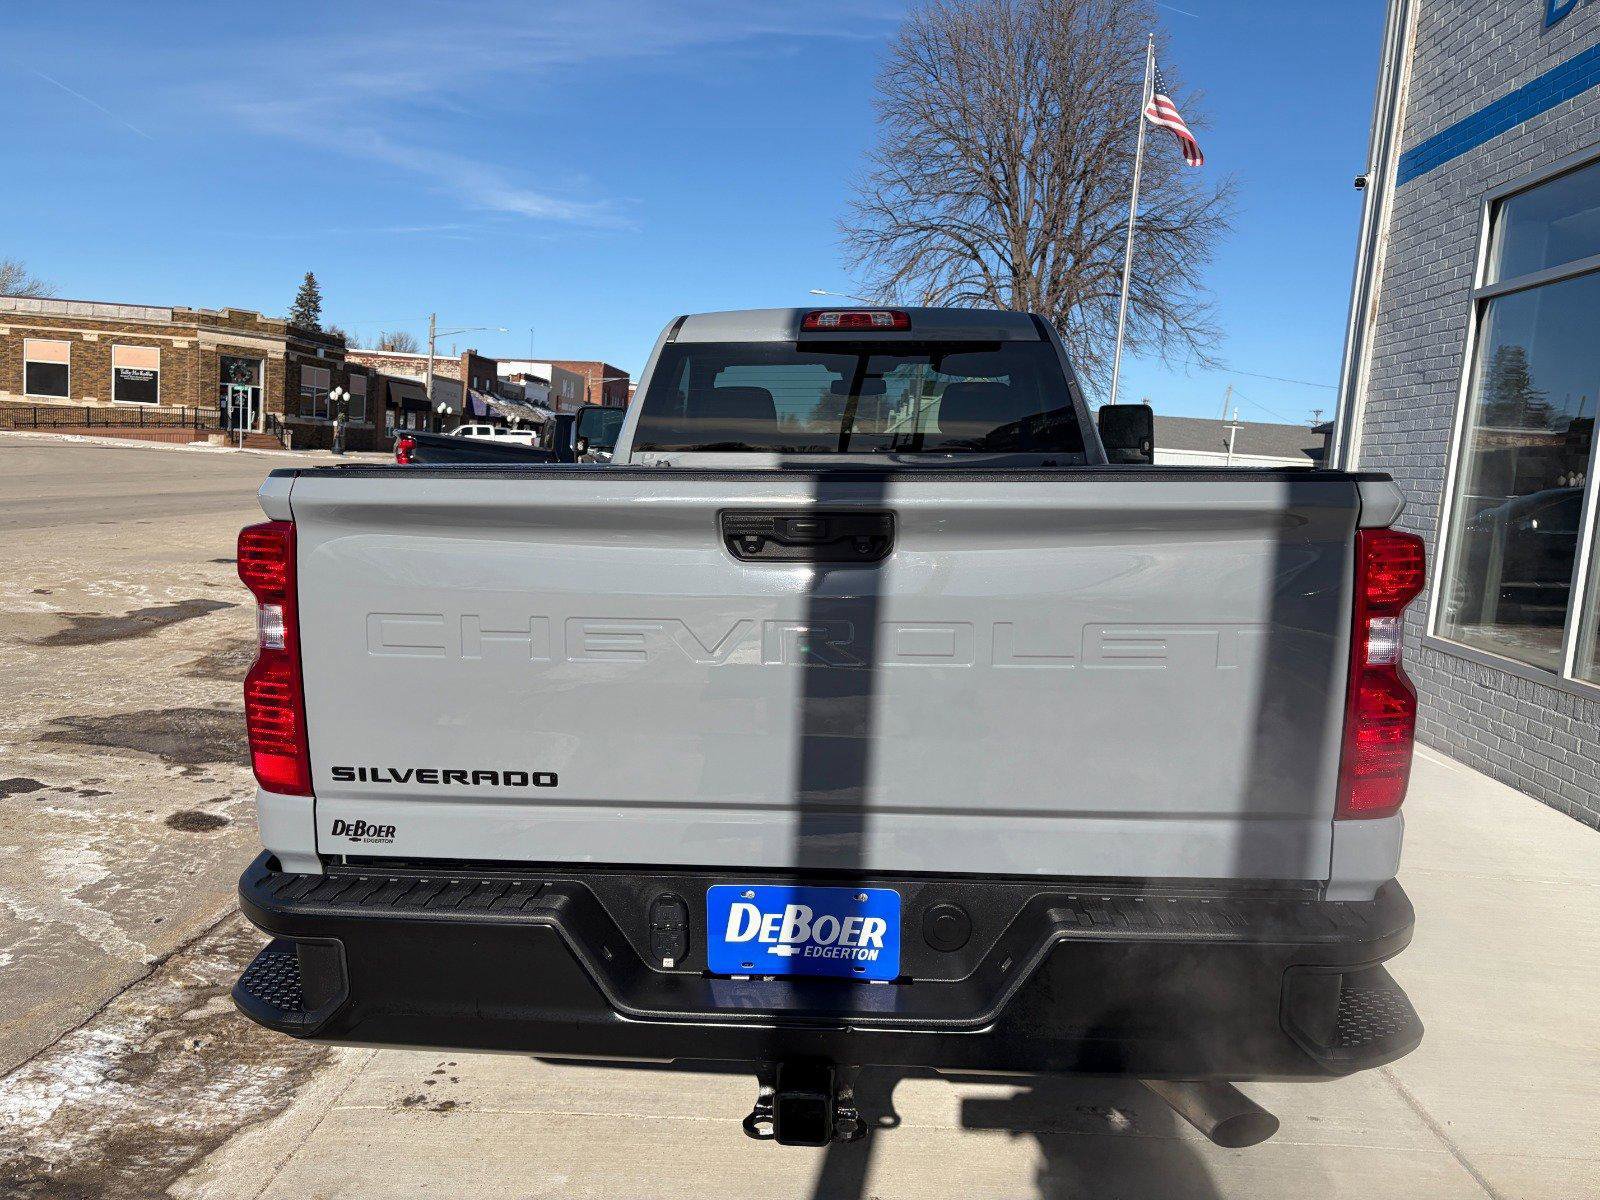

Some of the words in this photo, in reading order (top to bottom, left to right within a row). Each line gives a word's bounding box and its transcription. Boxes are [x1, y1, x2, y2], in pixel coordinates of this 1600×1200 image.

[366, 612, 1275, 671] CHEVROLET
[331, 766, 559, 787] SILVERADO
[804, 945, 880, 961] EDGERTON
